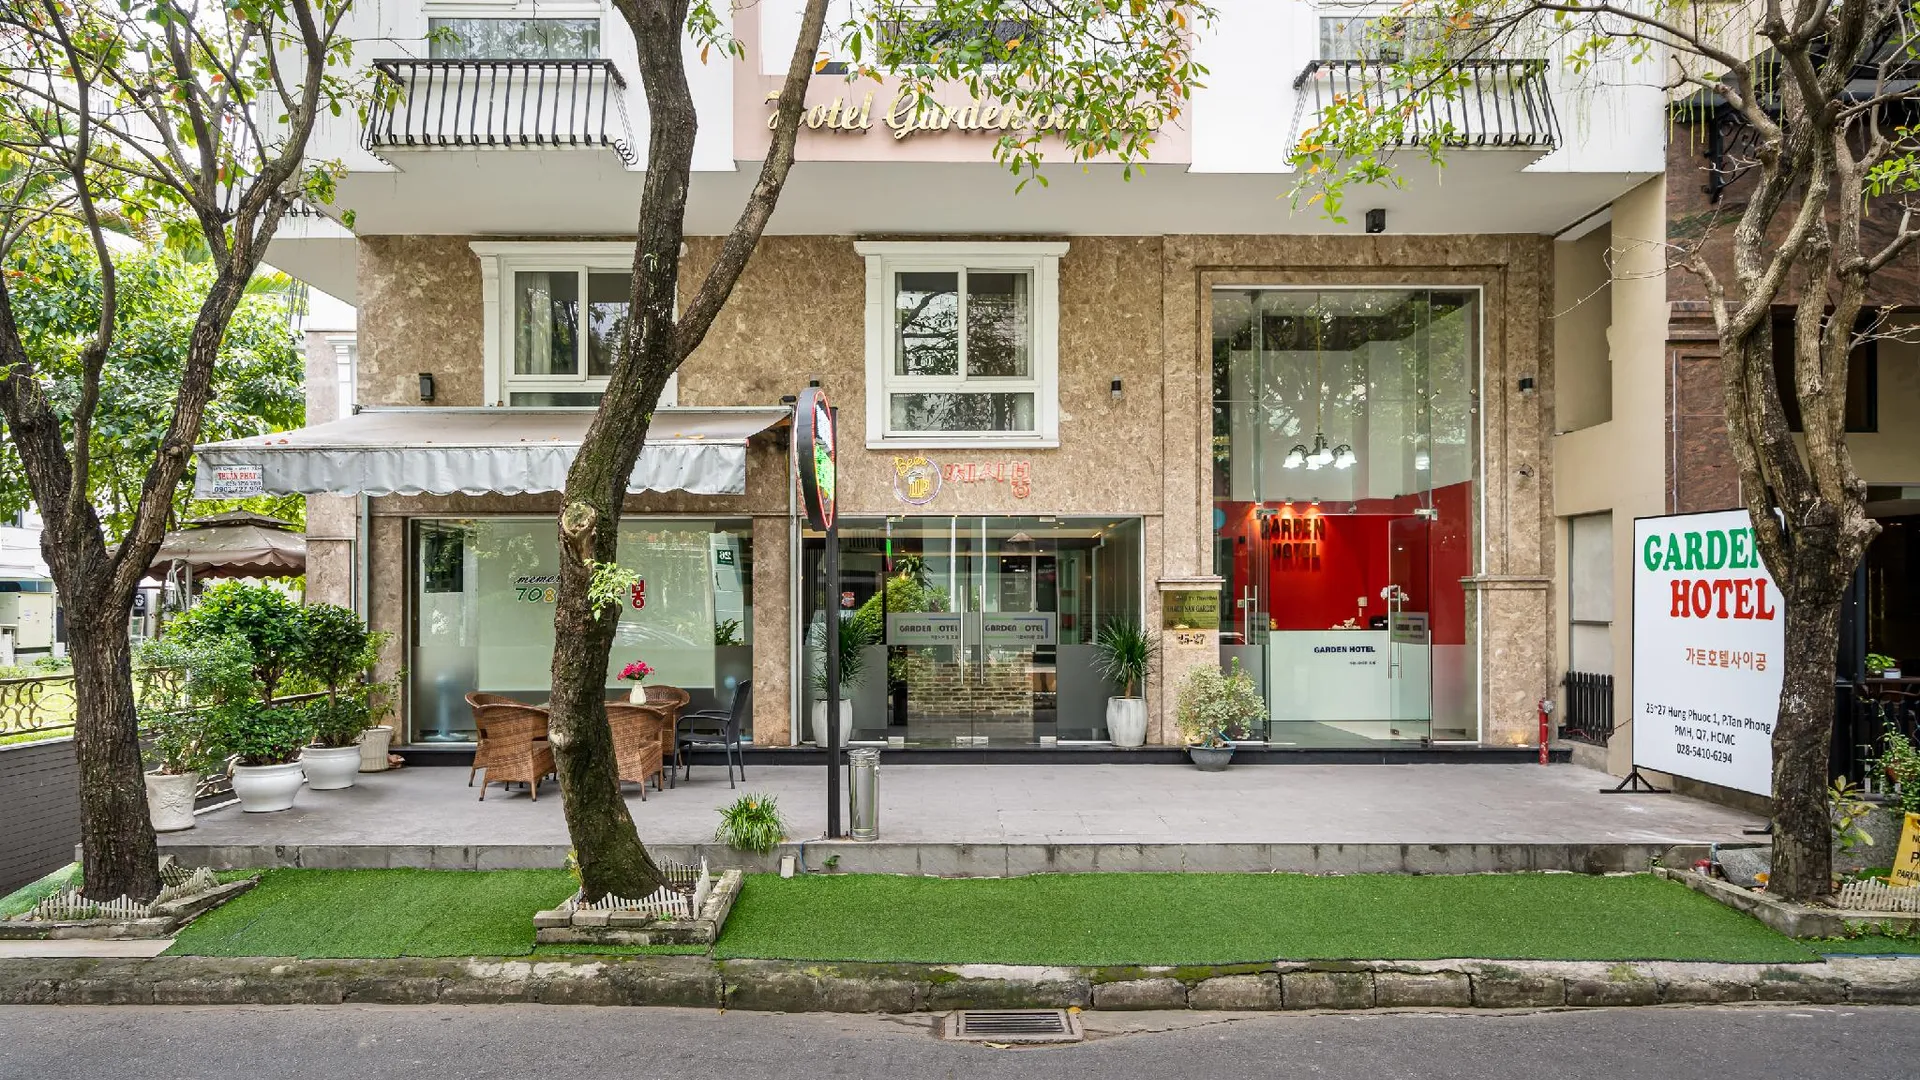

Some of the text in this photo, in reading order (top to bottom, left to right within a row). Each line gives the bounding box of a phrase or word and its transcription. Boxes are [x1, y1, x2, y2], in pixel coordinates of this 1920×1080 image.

[515, 587, 559, 603] 708
[1670, 578, 1775, 621] HOTEL
[1686, 648, 1767, 672] 가든호텔사이공
[1668, 706, 1687, 721] Hung
[1688, 709, 1711, 723] Phuoc
[1744, 718, 1772, 735] Phong
[1711, 731, 1736, 746] HCMC
[1676, 743, 1733, 763] 028-5410-6294
